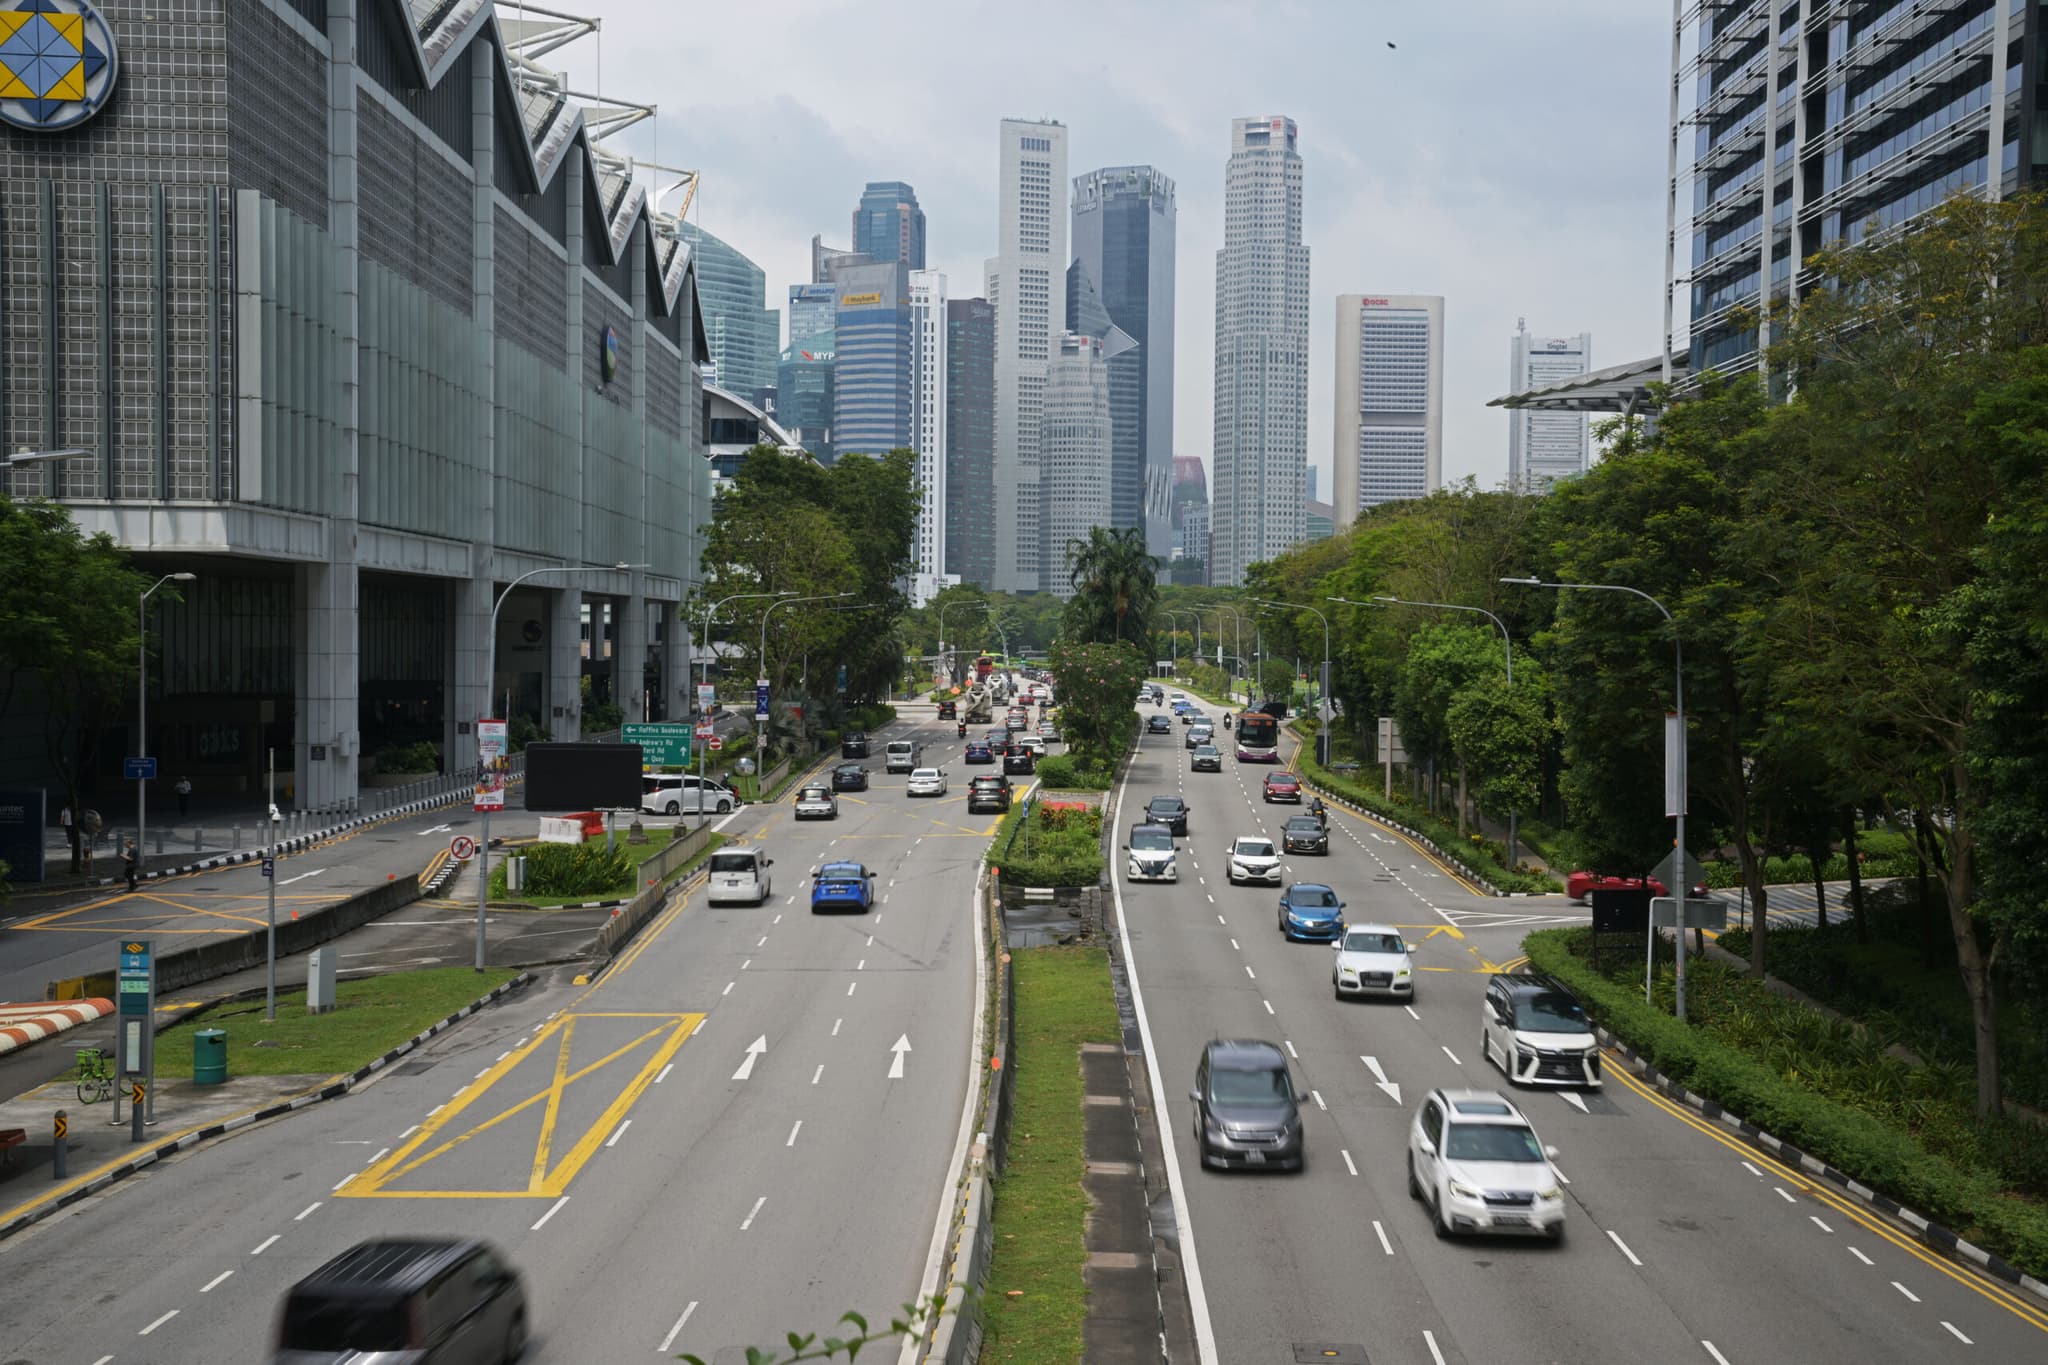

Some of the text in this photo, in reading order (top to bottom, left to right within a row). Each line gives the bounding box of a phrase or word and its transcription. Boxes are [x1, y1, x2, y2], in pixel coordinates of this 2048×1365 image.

[1370, 298, 1389, 306] OCBC
[1547, 343, 1568, 351] Singtel
[813, 352, 835, 360] MYP
[651, 755, 664, 764] Quay
